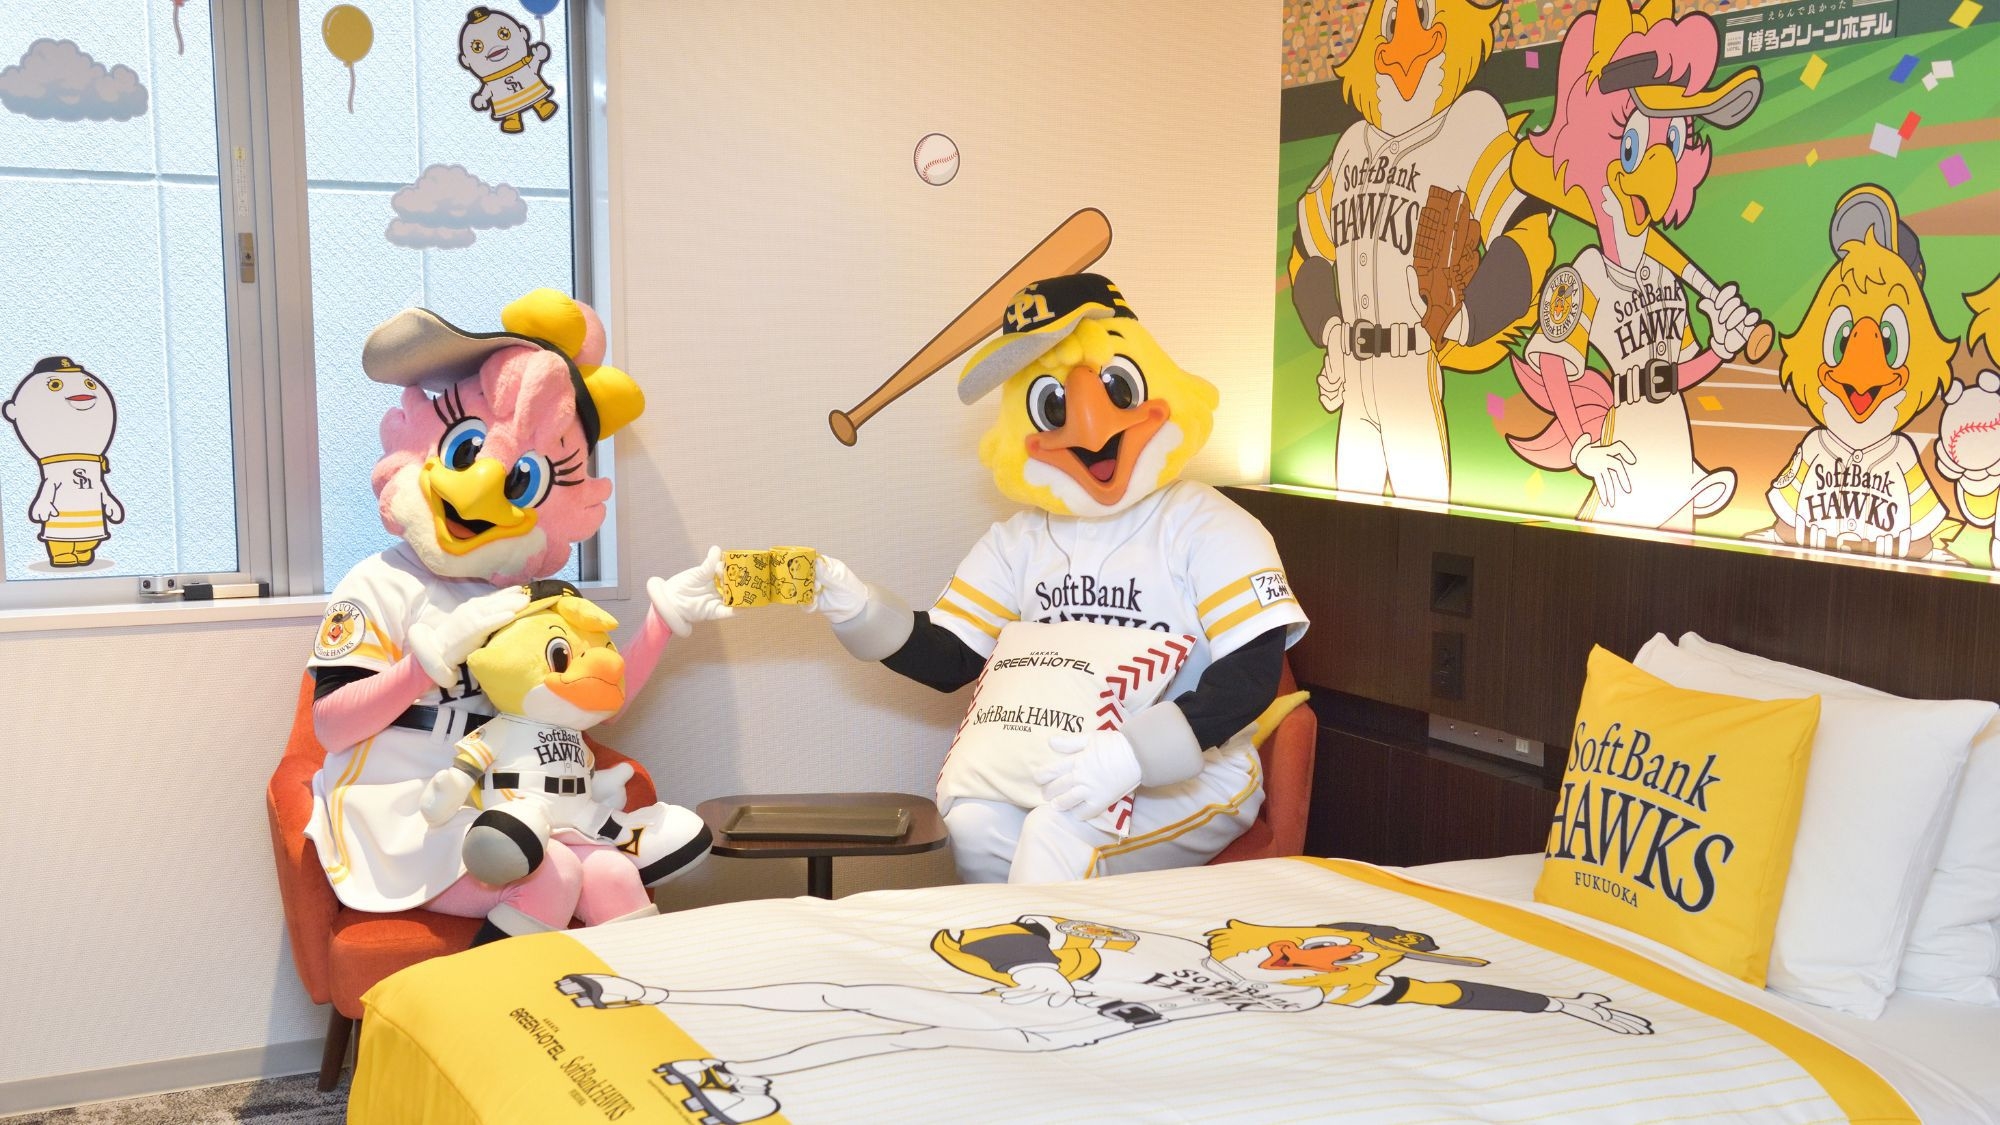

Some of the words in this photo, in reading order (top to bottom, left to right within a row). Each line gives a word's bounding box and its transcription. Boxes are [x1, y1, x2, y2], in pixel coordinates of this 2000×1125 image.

[1768, 0, 1847, 20] えらんで良かった
[1748, 12, 1893, 53] 博多グリーンホテル
[1343, 156, 1421, 193] SoftBank
[1332, 192, 1420, 255] HAWKS
[1614, 279, 1682, 323] SoftBank
[1815, 457, 1895, 497] SoftBank
[1805, 491, 1898, 532] HAWKS
[1035, 574, 1142, 612] SoftBank
[1265, 585, 1290, 600] 九州
[994, 657, 1039, 671] GREEN
[1040, 657, 1095, 675] HOTEL
[537, 729, 581, 745] SoftBank
[973, 705, 1025, 725] SoftBank
[1025, 706, 1084, 733] HAWKS
[1003, 724, 1032, 733] FUKUOKA
[534, 743, 585, 768] HAWKS
[1568, 721, 1721, 812] SoftBank
[1545, 779, 1735, 913] HAWKS
[1574, 871, 1638, 908] FUKUOKA
[509, 1007, 544, 1035] GREEN
[532, 1028, 566, 1061] HOTEL
